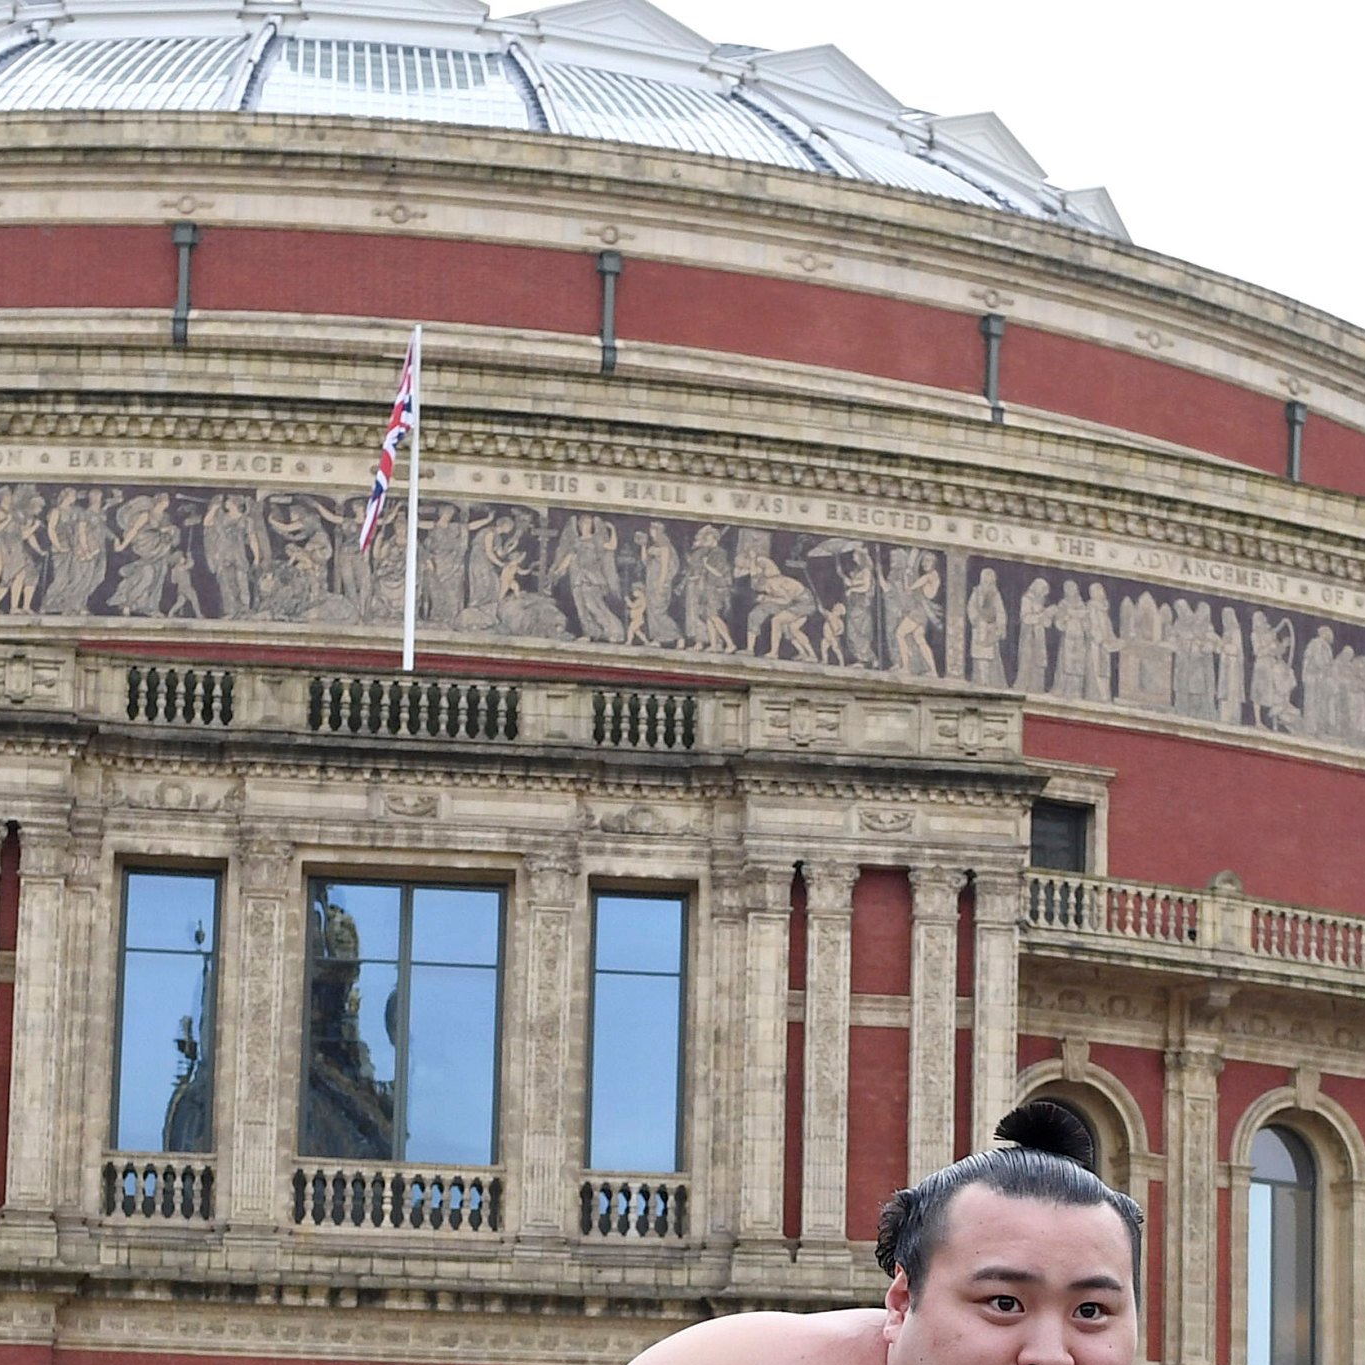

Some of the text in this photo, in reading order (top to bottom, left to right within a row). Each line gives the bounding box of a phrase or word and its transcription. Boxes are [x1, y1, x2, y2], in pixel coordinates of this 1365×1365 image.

[67, 450, 155, 469] EARTH
[200, 453, 284, 474] PEACE
[523, 473, 579, 493] THIS
[623, 481, 687, 503] HALL
[730, 491, 783, 514] WAS
[826, 503, 933, 533] ERECTED
[972, 523, 1015, 545] FOR
[1055, 537, 1096, 558] THE
[1133, 551, 1289, 593] ADVANCEMENT
[1321, 587, 1344, 606] OF
